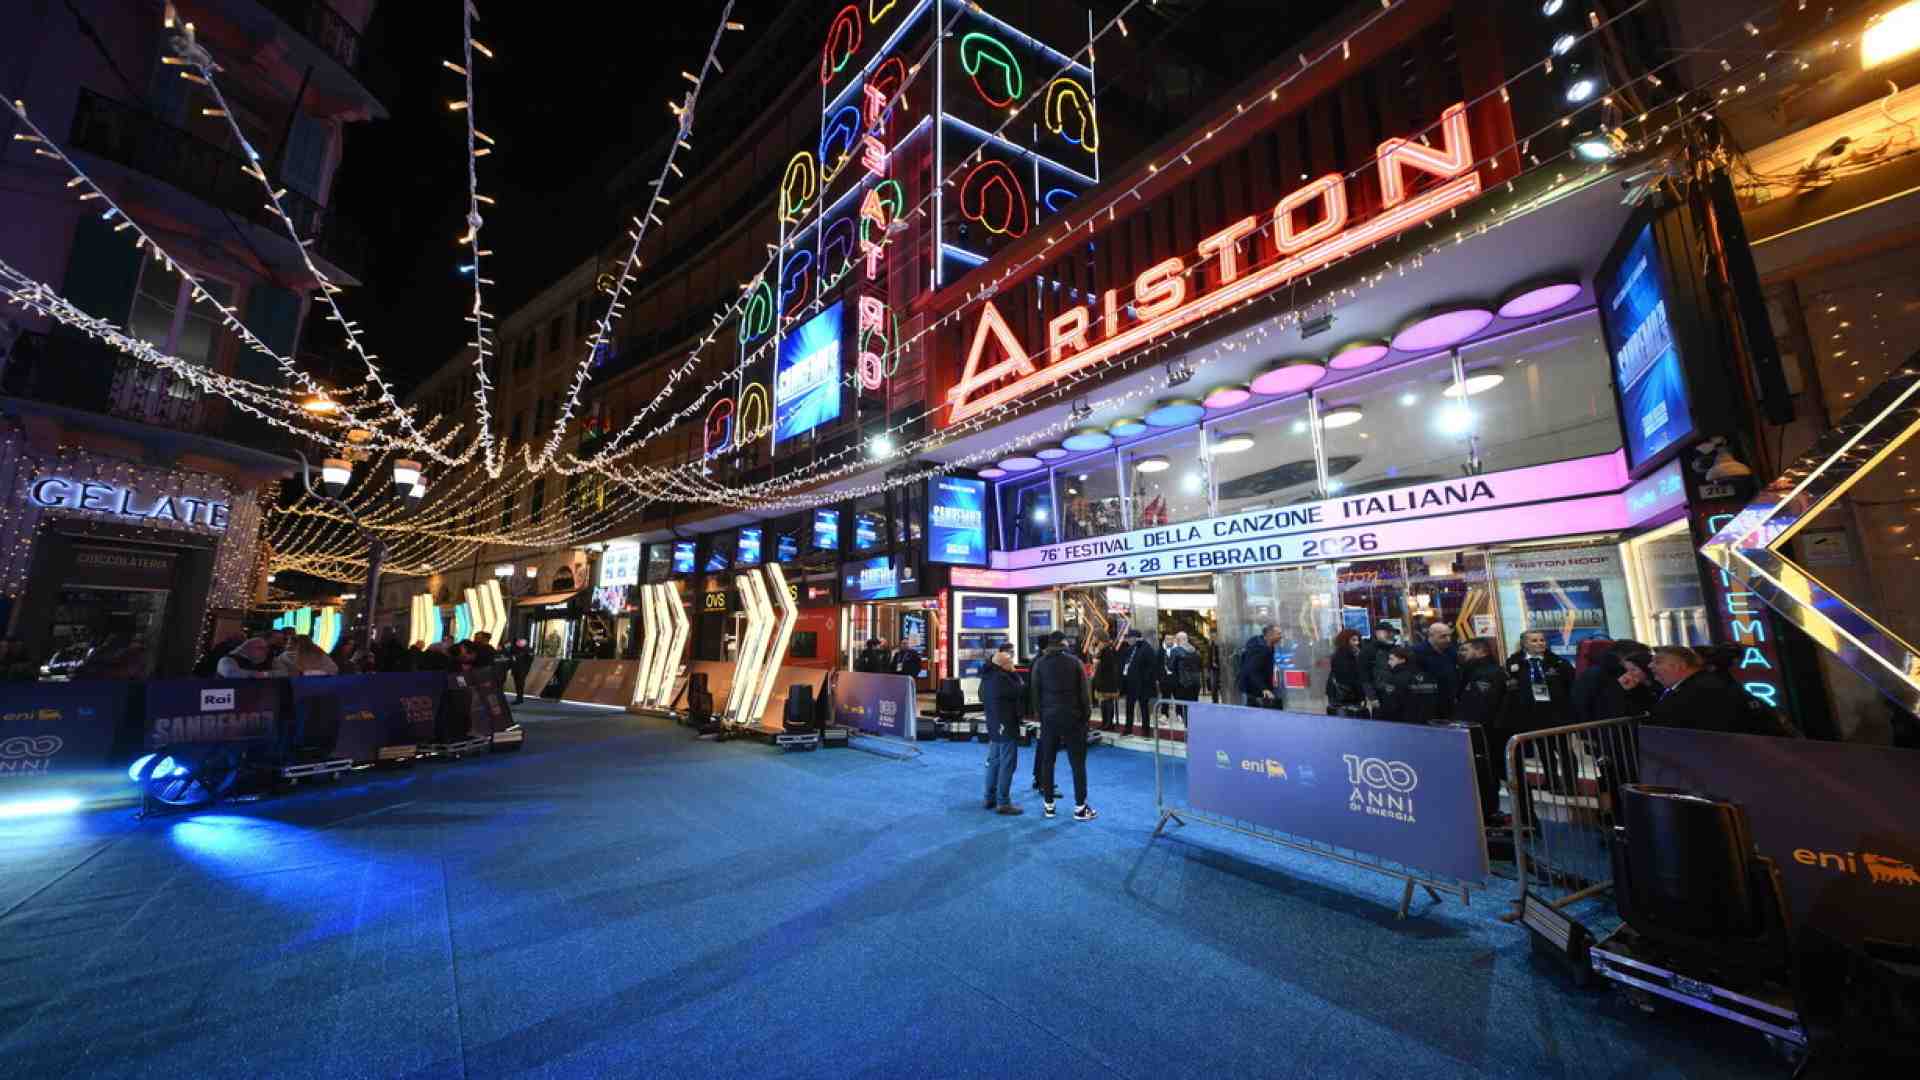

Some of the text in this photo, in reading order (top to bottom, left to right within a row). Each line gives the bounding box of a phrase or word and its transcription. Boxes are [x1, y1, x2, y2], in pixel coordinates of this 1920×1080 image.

[947, 101, 1478, 423] ARISTON
[32, 478, 232, 529] GELATE
[1064, 537, 1133, 559] FESTIVAL
[1143, 528, 1201, 548] DELLA
[1213, 505, 1323, 538] CANZONE
[1343, 480, 1496, 518] ITALIANA
[1173, 543, 1282, 570] FEBBRAIO
[1302, 532, 1379, 557] 2026
[705, 591, 726, 608] OVS
[203, 693, 233, 705] Rai
[1241, 758, 1265, 773] eni
[1342, 753, 1418, 793] 100
[1350, 786, 1413, 814] ANNI
[1366, 805, 1416, 824] ENERGIA
[1792, 848, 1857, 873] eni
